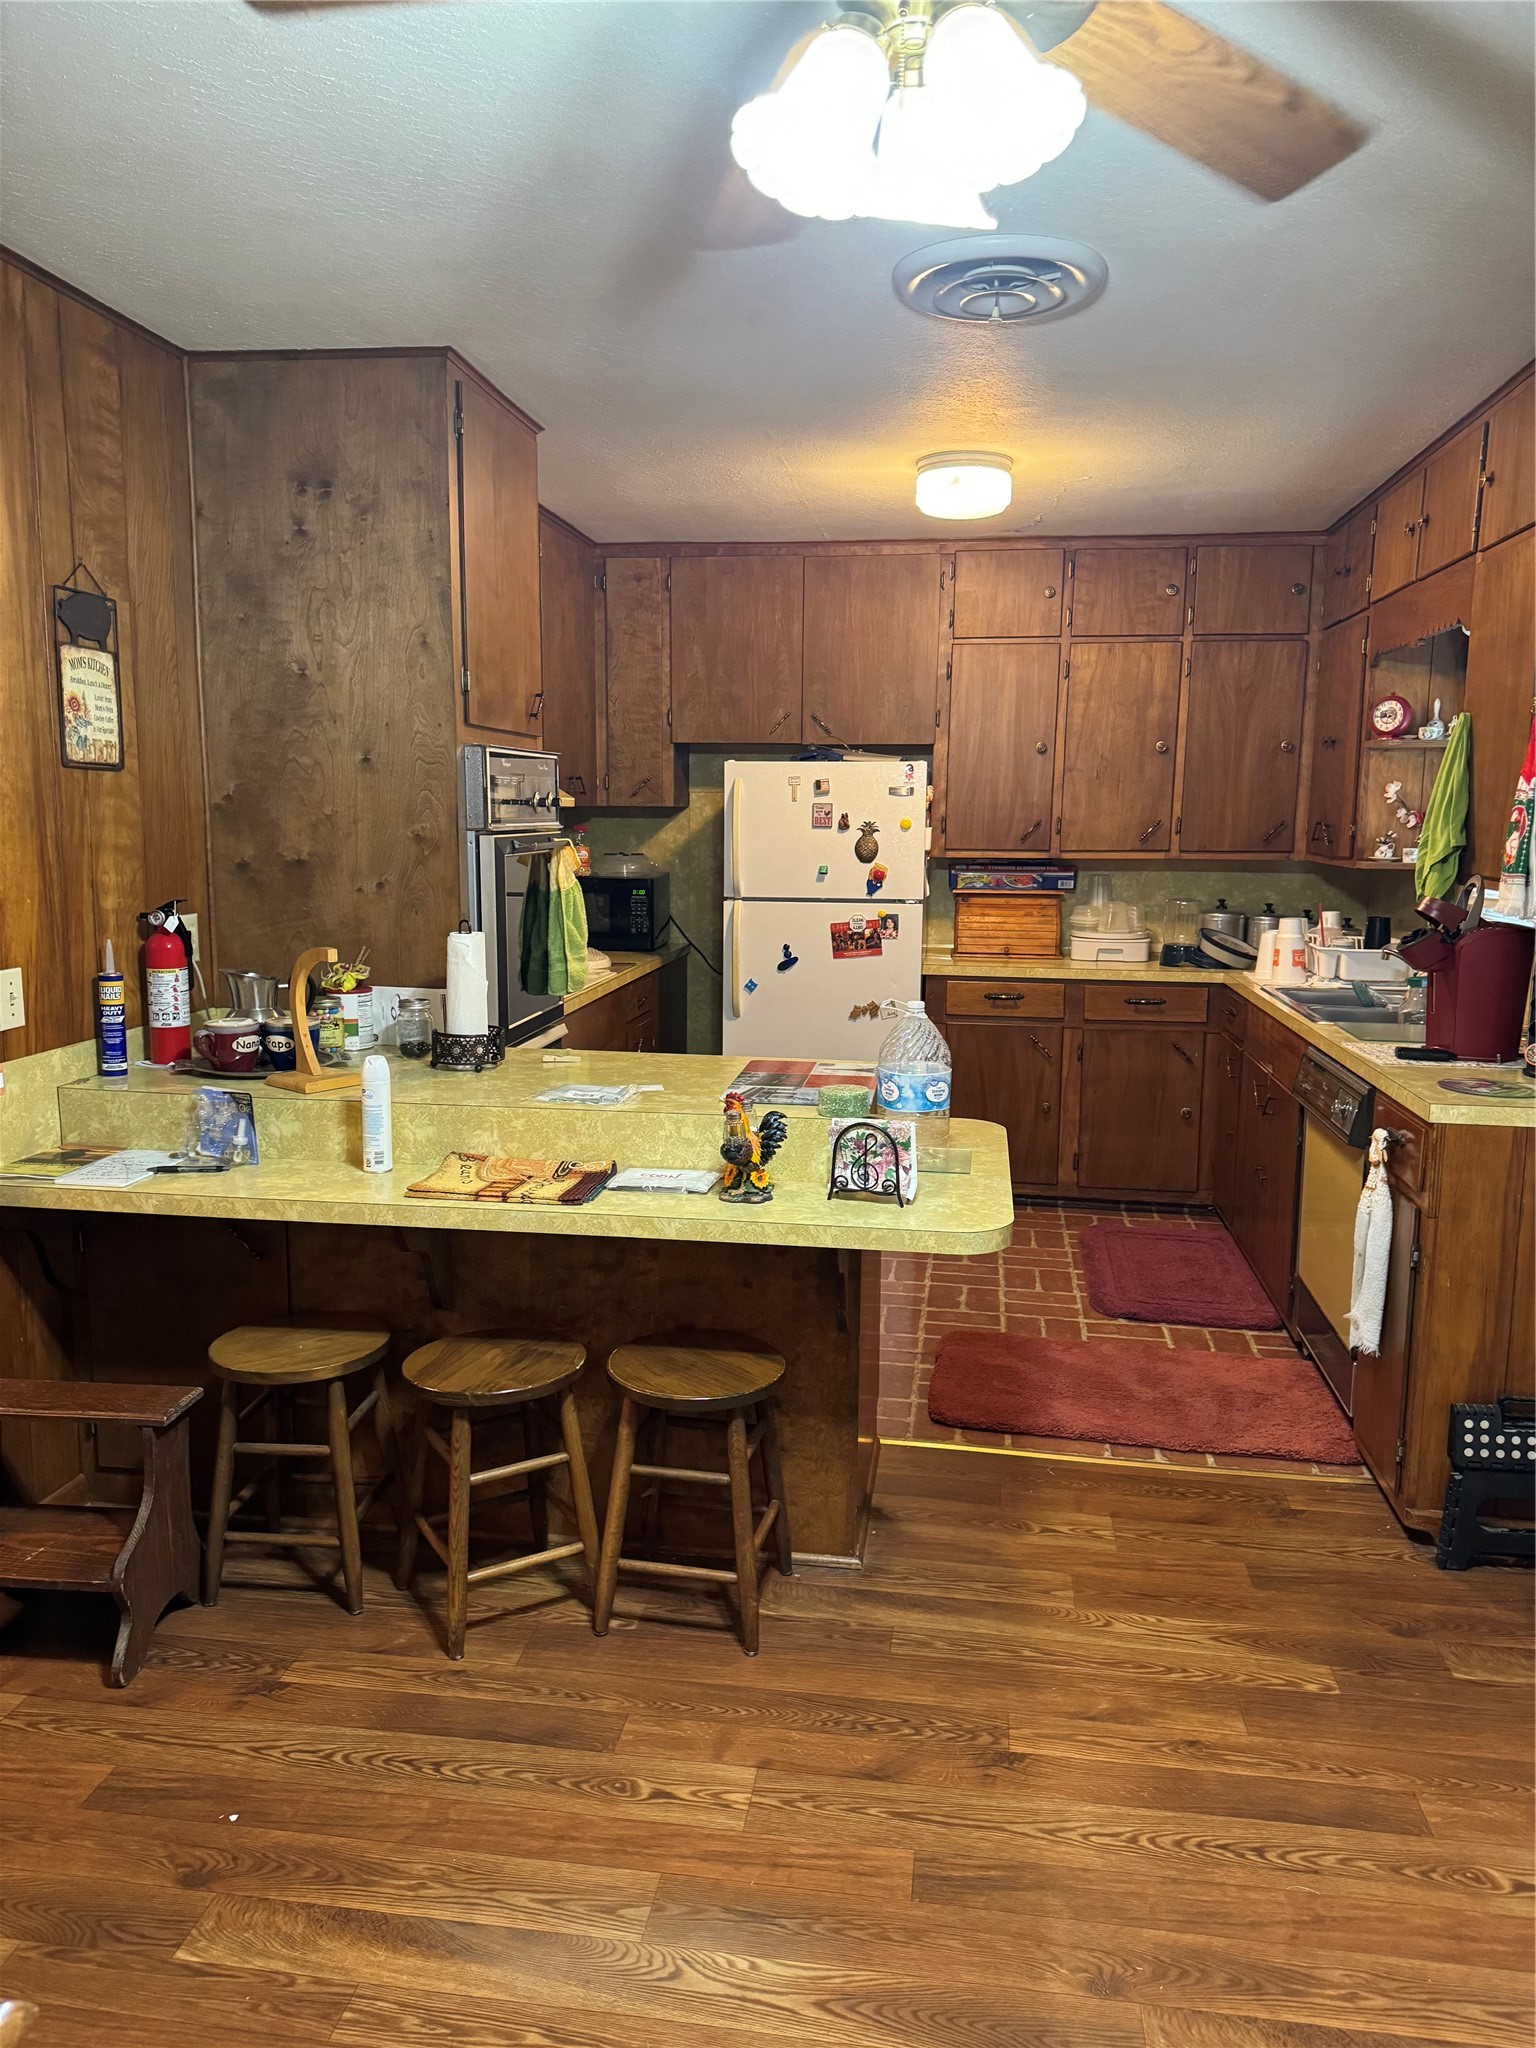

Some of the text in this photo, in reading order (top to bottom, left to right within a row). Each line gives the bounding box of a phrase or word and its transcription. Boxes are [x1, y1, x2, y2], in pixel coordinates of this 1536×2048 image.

[87, 657, 109, 678] KITCHEN
[100, 986, 122, 994] LIQUID
[266, 1037, 292, 1051] Papa
